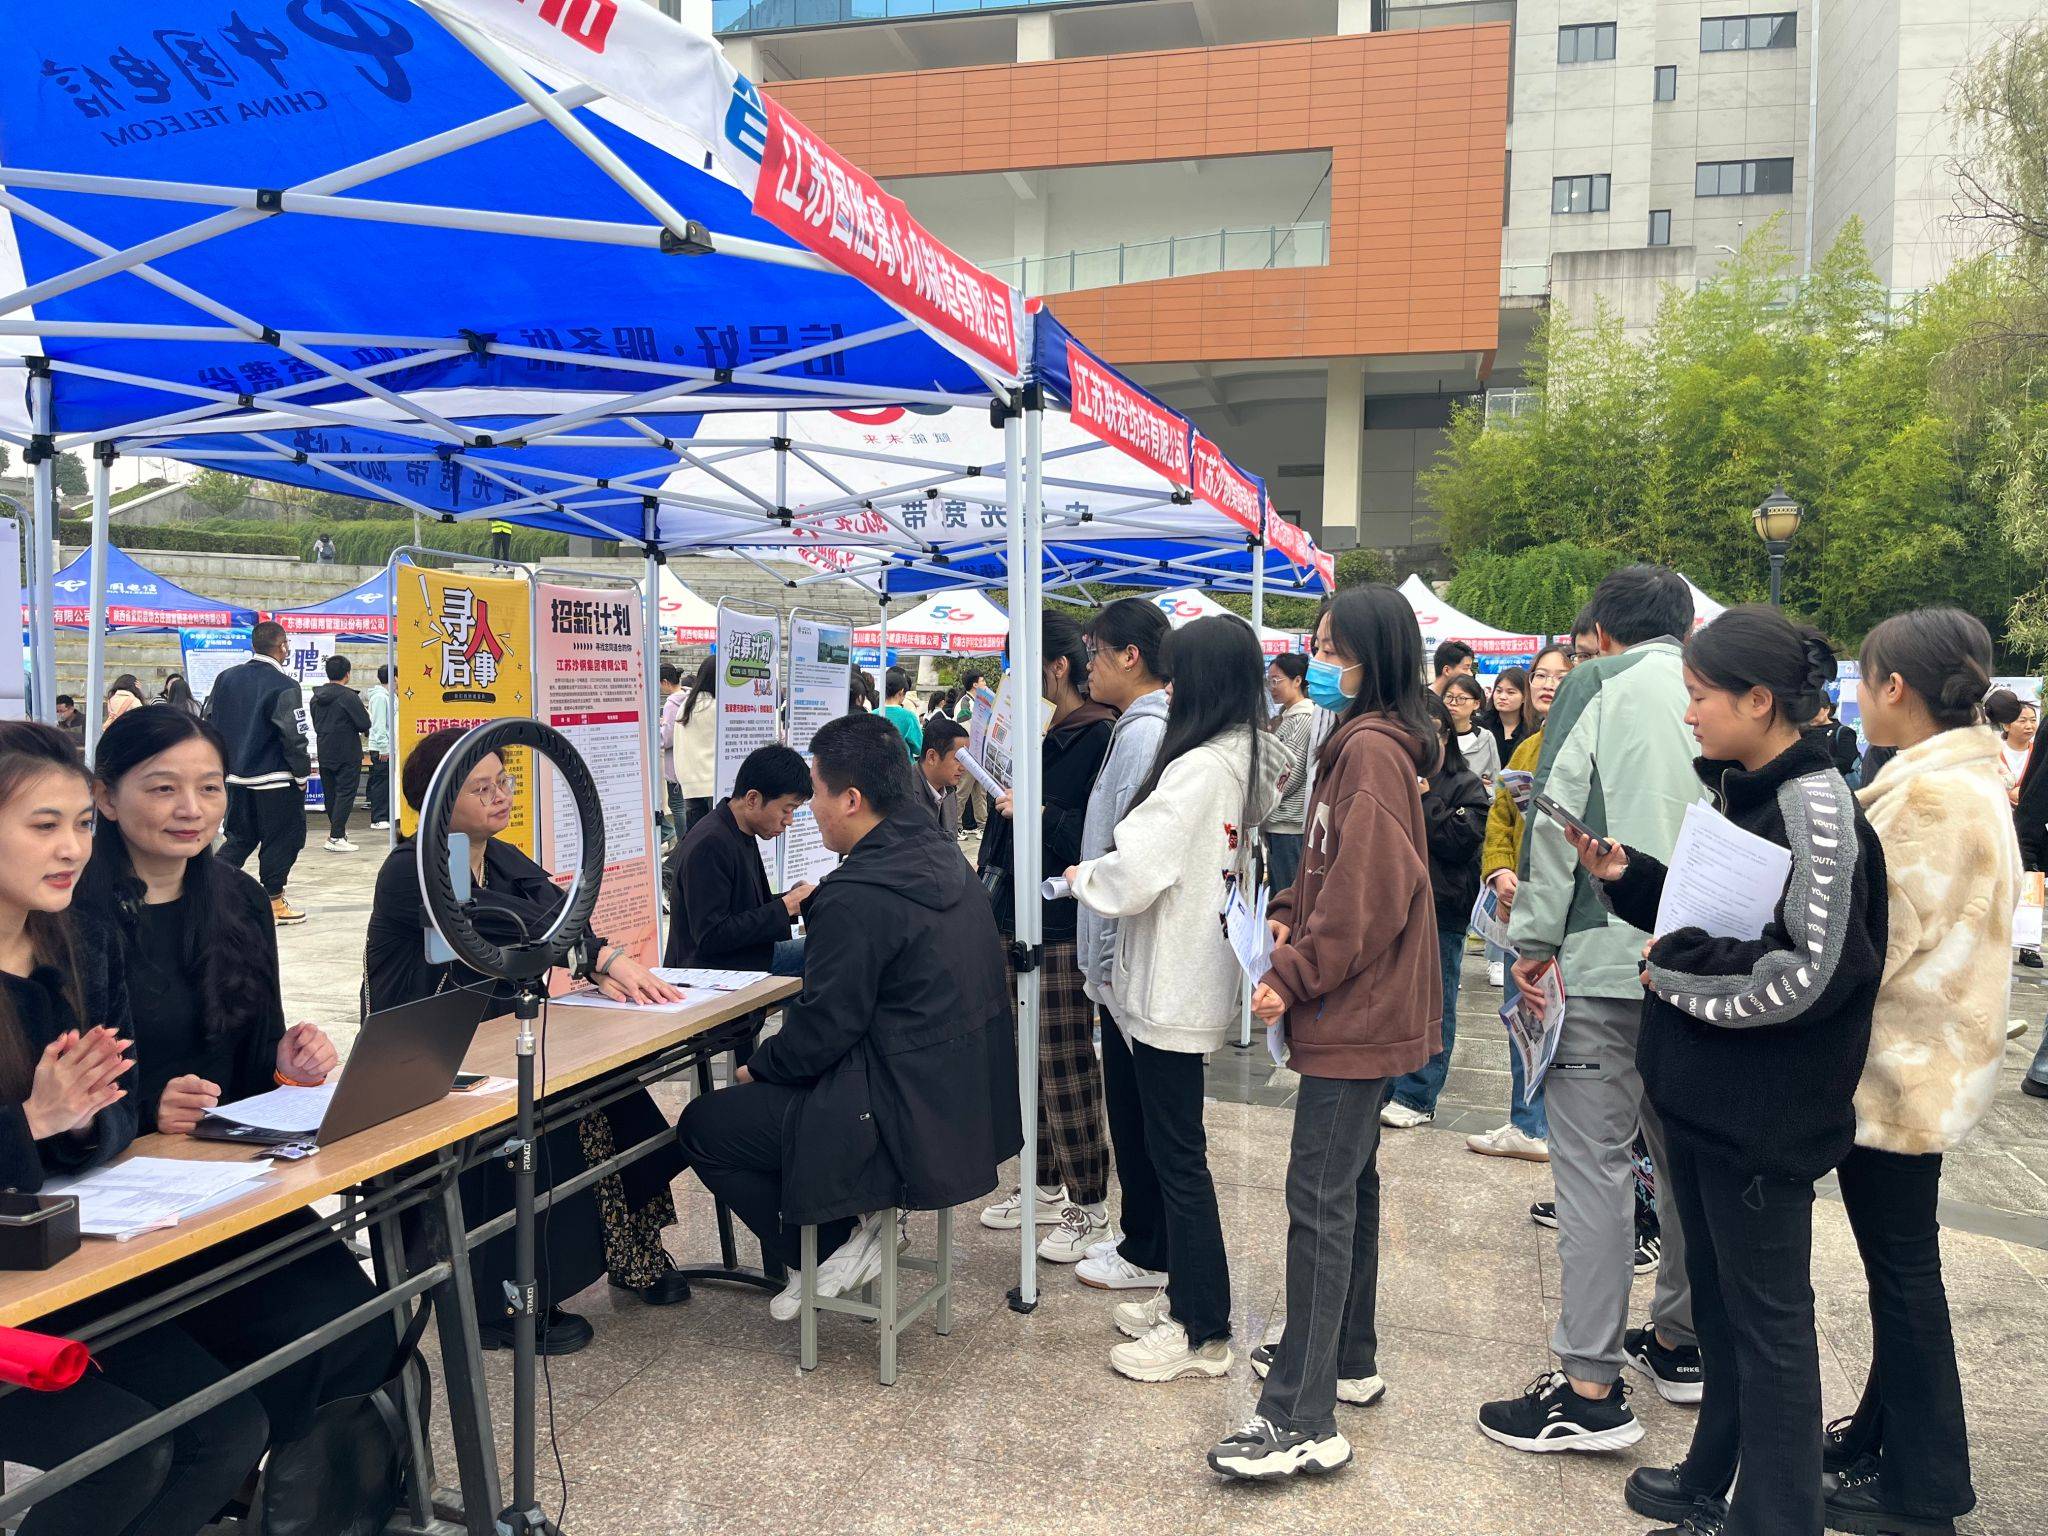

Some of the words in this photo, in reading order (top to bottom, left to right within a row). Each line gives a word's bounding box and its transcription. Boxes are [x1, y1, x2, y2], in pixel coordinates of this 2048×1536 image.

[930, 605, 975, 622] 5G
[1158, 598, 1202, 617] 5G
[551, 599, 631, 636] 招新计划
[728, 630, 772, 663] 招募计划
[556, 659, 628, 672] 江苏沙钢集团有限公司
[1806, 790, 1836, 800] YOUTH
[1812, 818, 1838, 830] YOUTH
[1780, 974, 1797, 1001] YOUTH
[1747, 992, 1766, 1014] YOUTH
